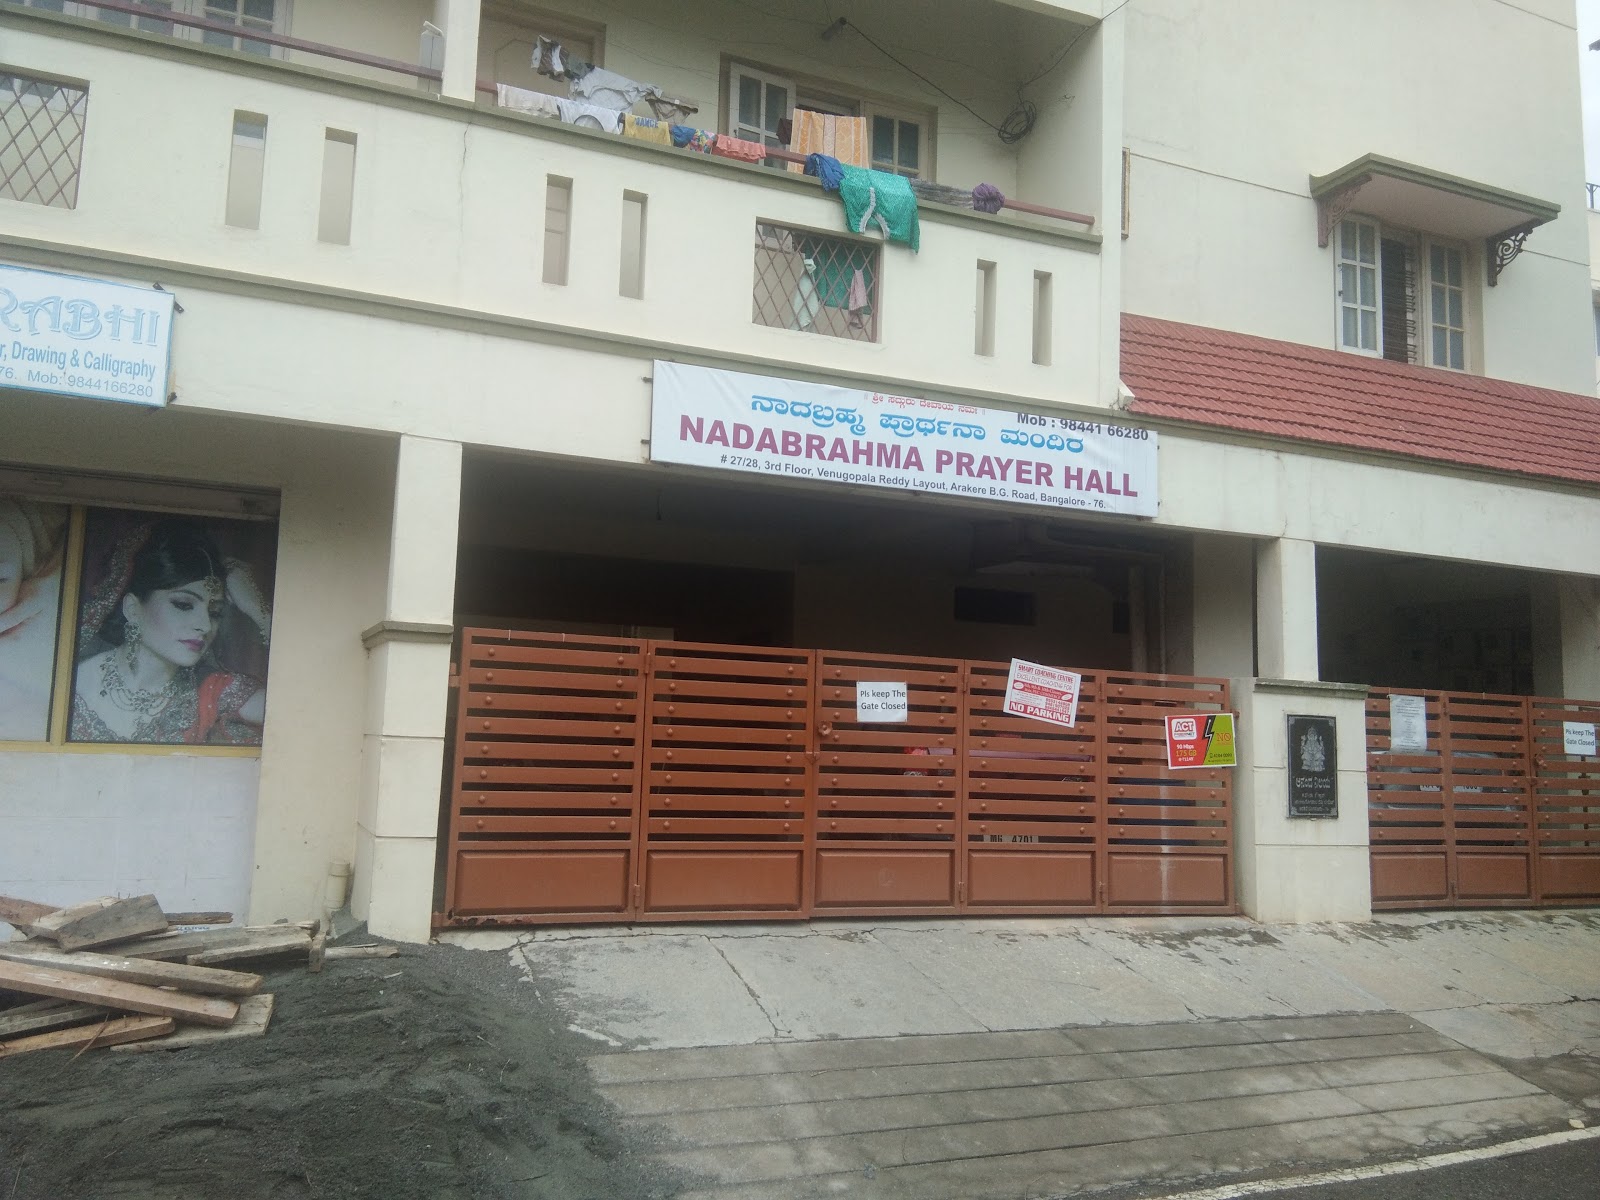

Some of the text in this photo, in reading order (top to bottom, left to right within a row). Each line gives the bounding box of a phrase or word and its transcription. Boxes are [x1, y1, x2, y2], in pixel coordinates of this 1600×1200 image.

[12, 341, 66, 370] Drawing
[70, 348, 80, 368] &
[84, 351, 156, 382] Calligraphy
[28, 369, 62, 385] Mob:
[68, 376, 153, 398] 9844166280
[751, 394, 1084, 454] ನಾದಬ್ರಹ್ಮ ಪ್ರಾರ್ಥನಾ ಮಂದಿರ
[1017, 412, 1047, 427] Mob
[1060, 419, 1102, 435] 98441
[1107, 425, 1149, 441] 66280
[679, 414, 1138, 498] NADABRAHMA PRAYER HALL
[720, 454, 728, 464] #
[730, 455, 761, 470] 27/28,
[764, 460, 782, 472] 3rd
[785, 463, 814, 477] Floor,
[817, 467, 876, 483] Venugopala
[879, 474, 910, 487] Reddy
[913, 478, 949, 491] Layout,
[950, 482, 987, 495] Arakere
[989, 486, 1009, 498] B.G.
[1011, 489, 1038, 502] Road,
[1040, 492, 1086, 507] Bangalore
[1093, 499, 1106, 509] 76.
[860, 689, 906, 699] Pls keep The
[1063, 683, 1073, 691] FOR
[861, 702, 906, 710] Gate Closed
[1010, 702, 1025, 712] NO
[1026, 705, 1070, 722] PARKING
[1174, 721, 1194, 732] ACT
[1216, 733, 1232, 742] NO
